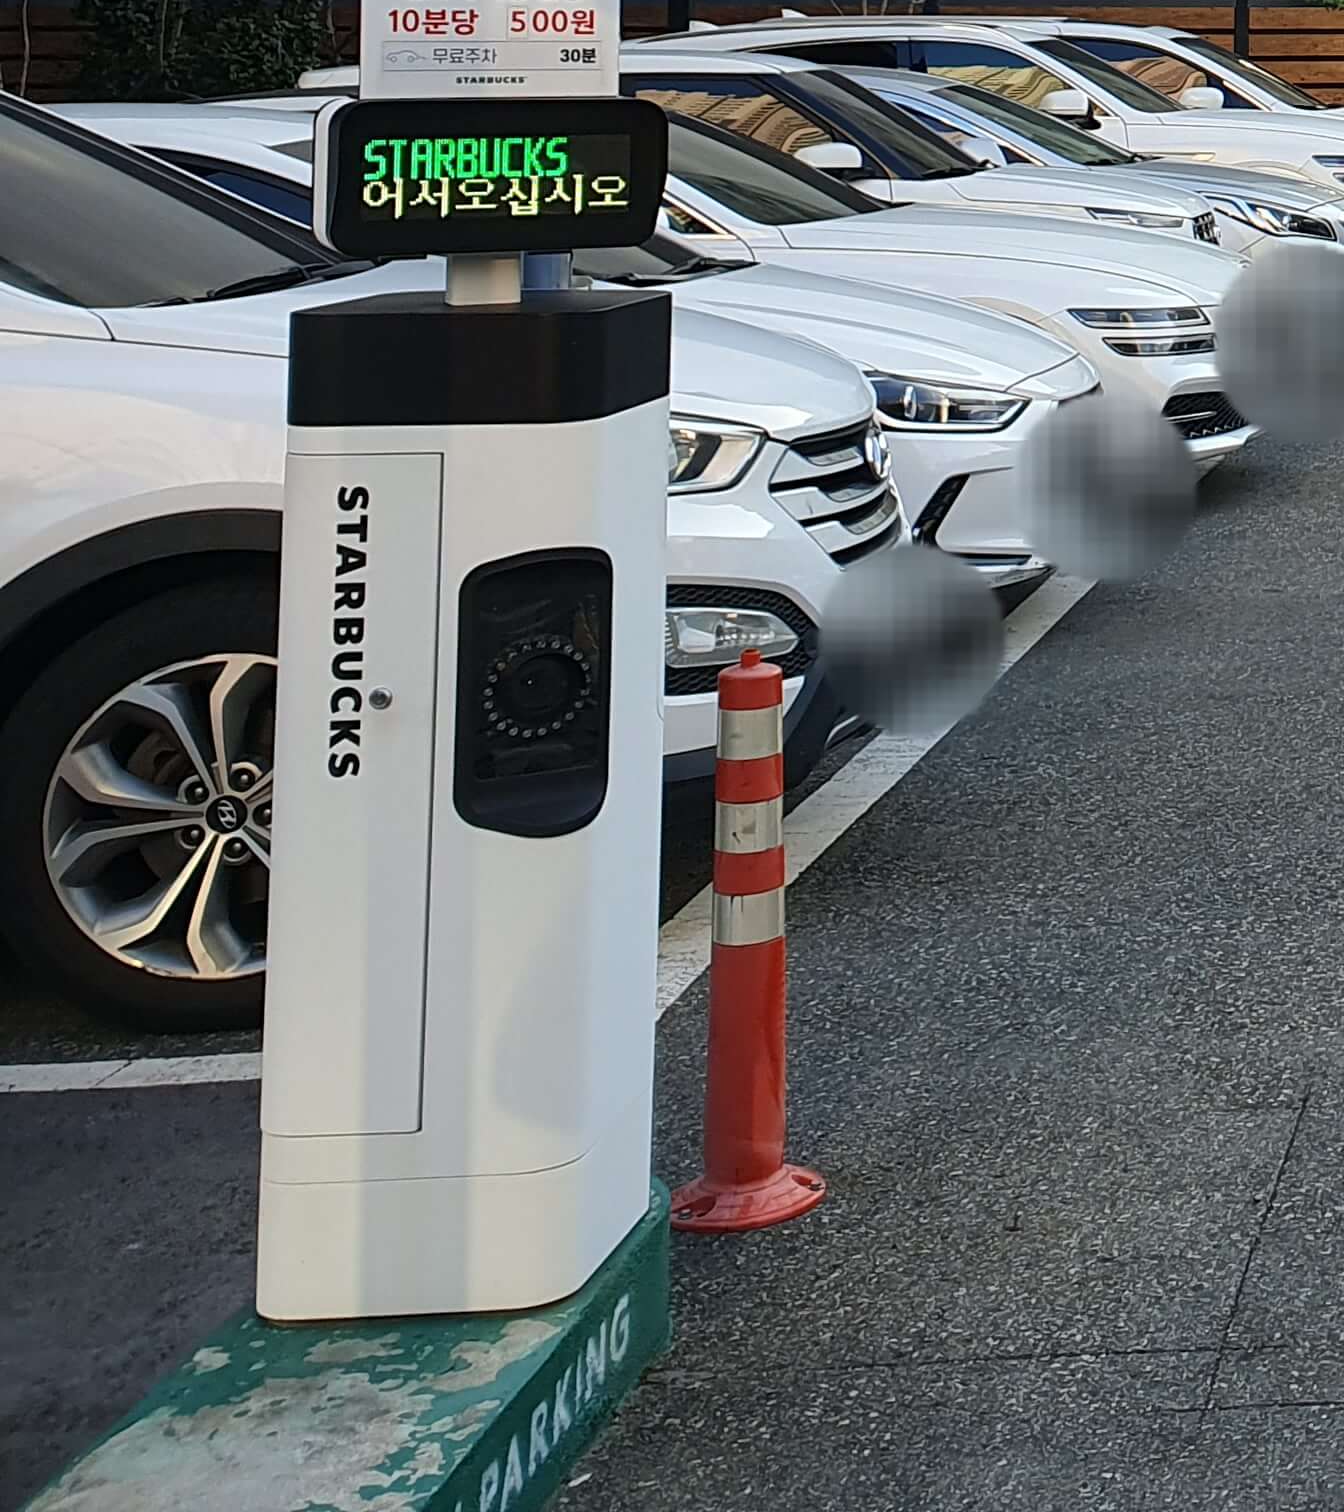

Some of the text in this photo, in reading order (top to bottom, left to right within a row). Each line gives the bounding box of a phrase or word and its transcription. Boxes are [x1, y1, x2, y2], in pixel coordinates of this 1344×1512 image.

[388, 9, 595, 35] 10분당 500원
[432, 48, 597, 64] 무료주차 30분
[456, 76, 525, 84] STARBUCKS
[364, 137, 568, 180] STARBUCKS
[363, 174, 629, 219] 어서오십시오
[327, 486, 369, 779] STARBUCKS
[480, 1293, 630, 1512] PARKING
